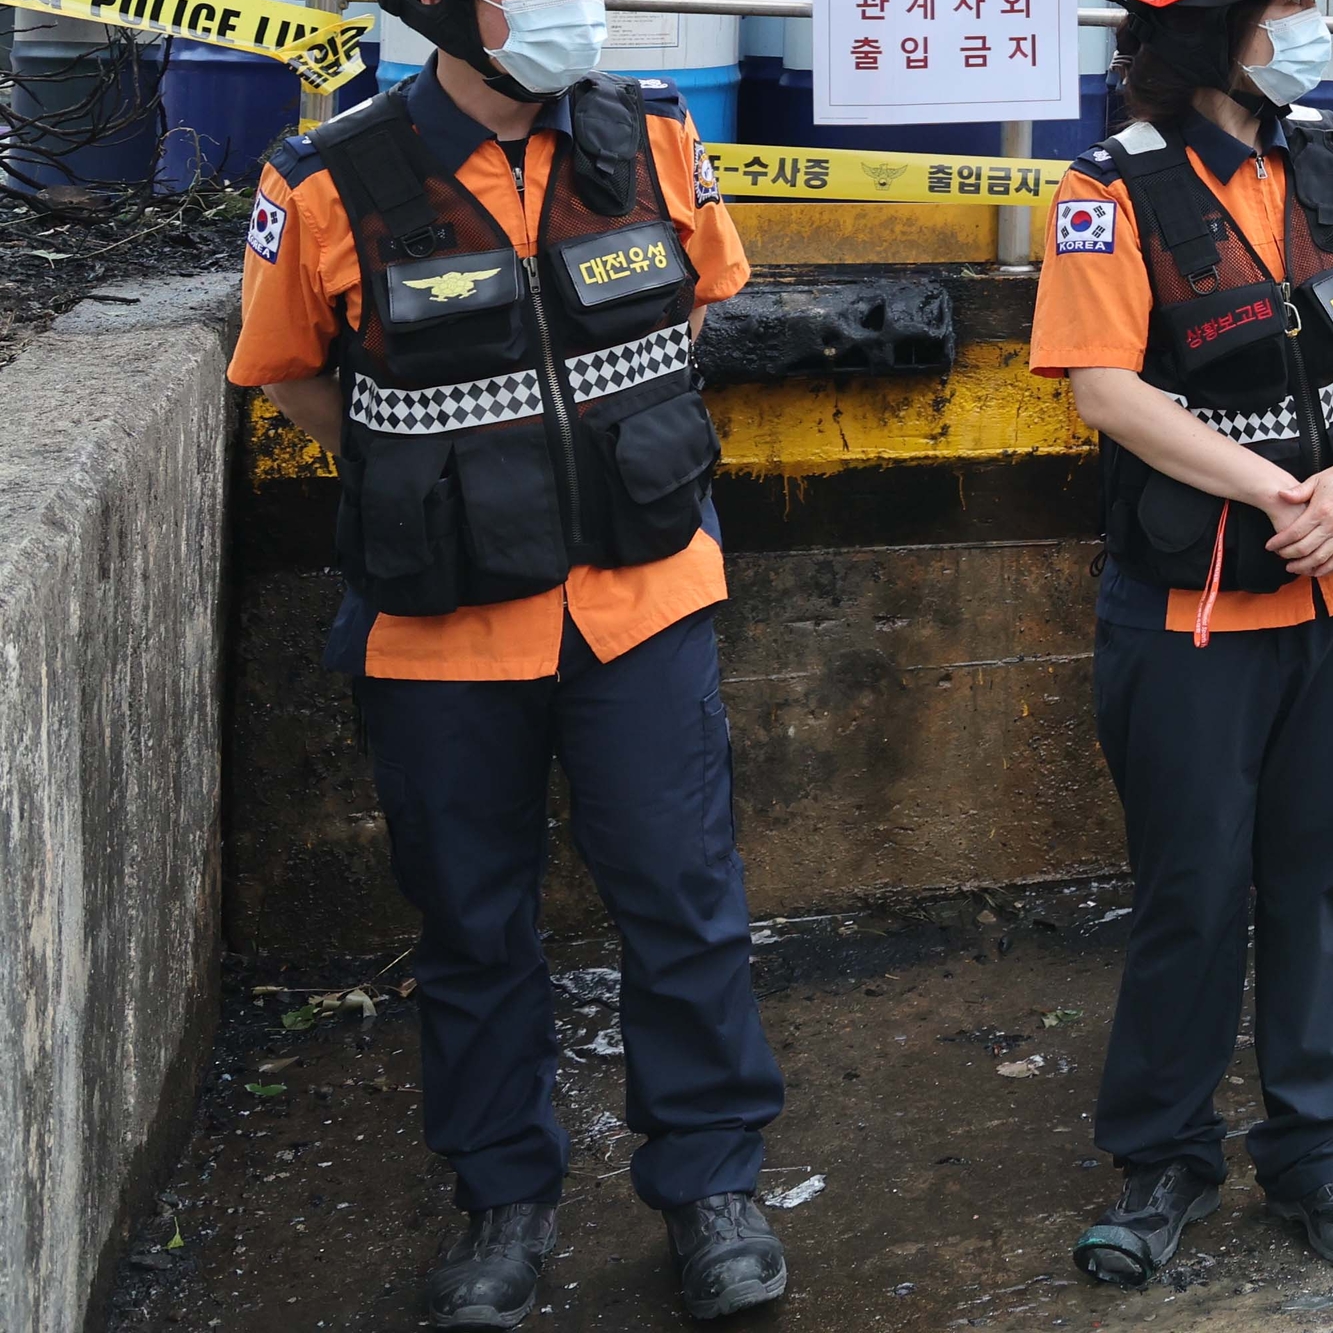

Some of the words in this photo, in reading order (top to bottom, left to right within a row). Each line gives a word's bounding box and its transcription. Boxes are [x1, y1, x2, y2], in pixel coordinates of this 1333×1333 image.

[254, 16, 319, 51] LI
[579, 241, 667, 285] 대전유성
[1059, 241, 1106, 252] KOREA
[1186, 297, 1273, 349] 상황보고팀
